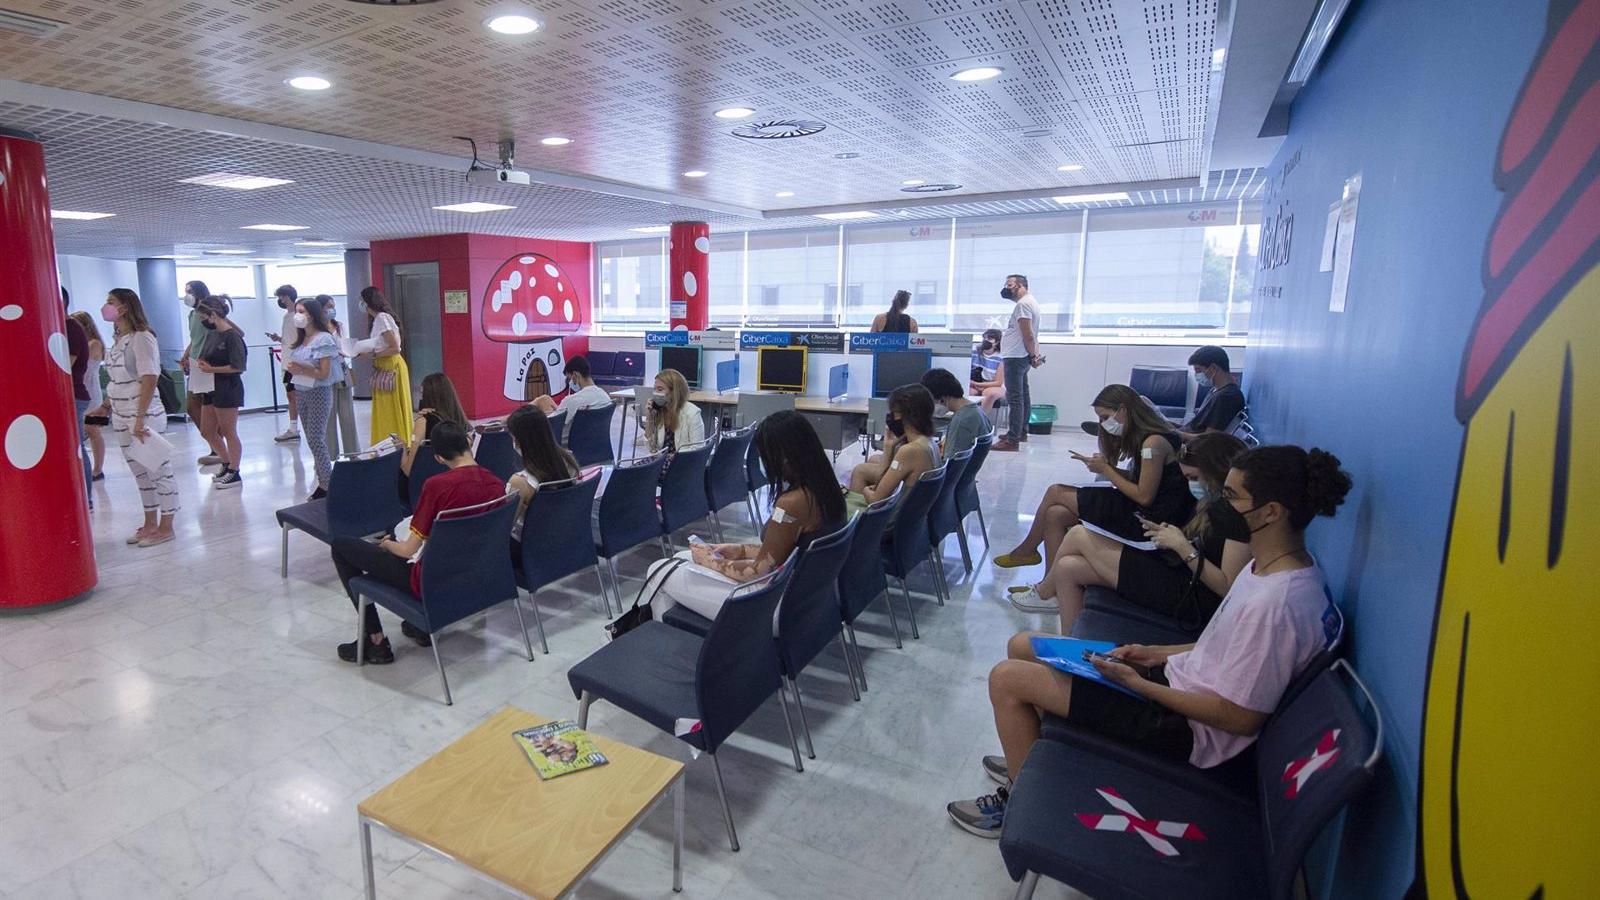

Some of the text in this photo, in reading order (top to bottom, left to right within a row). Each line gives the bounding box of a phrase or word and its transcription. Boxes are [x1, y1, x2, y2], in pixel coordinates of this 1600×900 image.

[647, 333, 688, 343] CiberCaixa
[742, 334, 789, 344] CiberCaixa
[852, 335, 906, 345] CiberCaixa
[516, 348, 536, 382] La Paz
